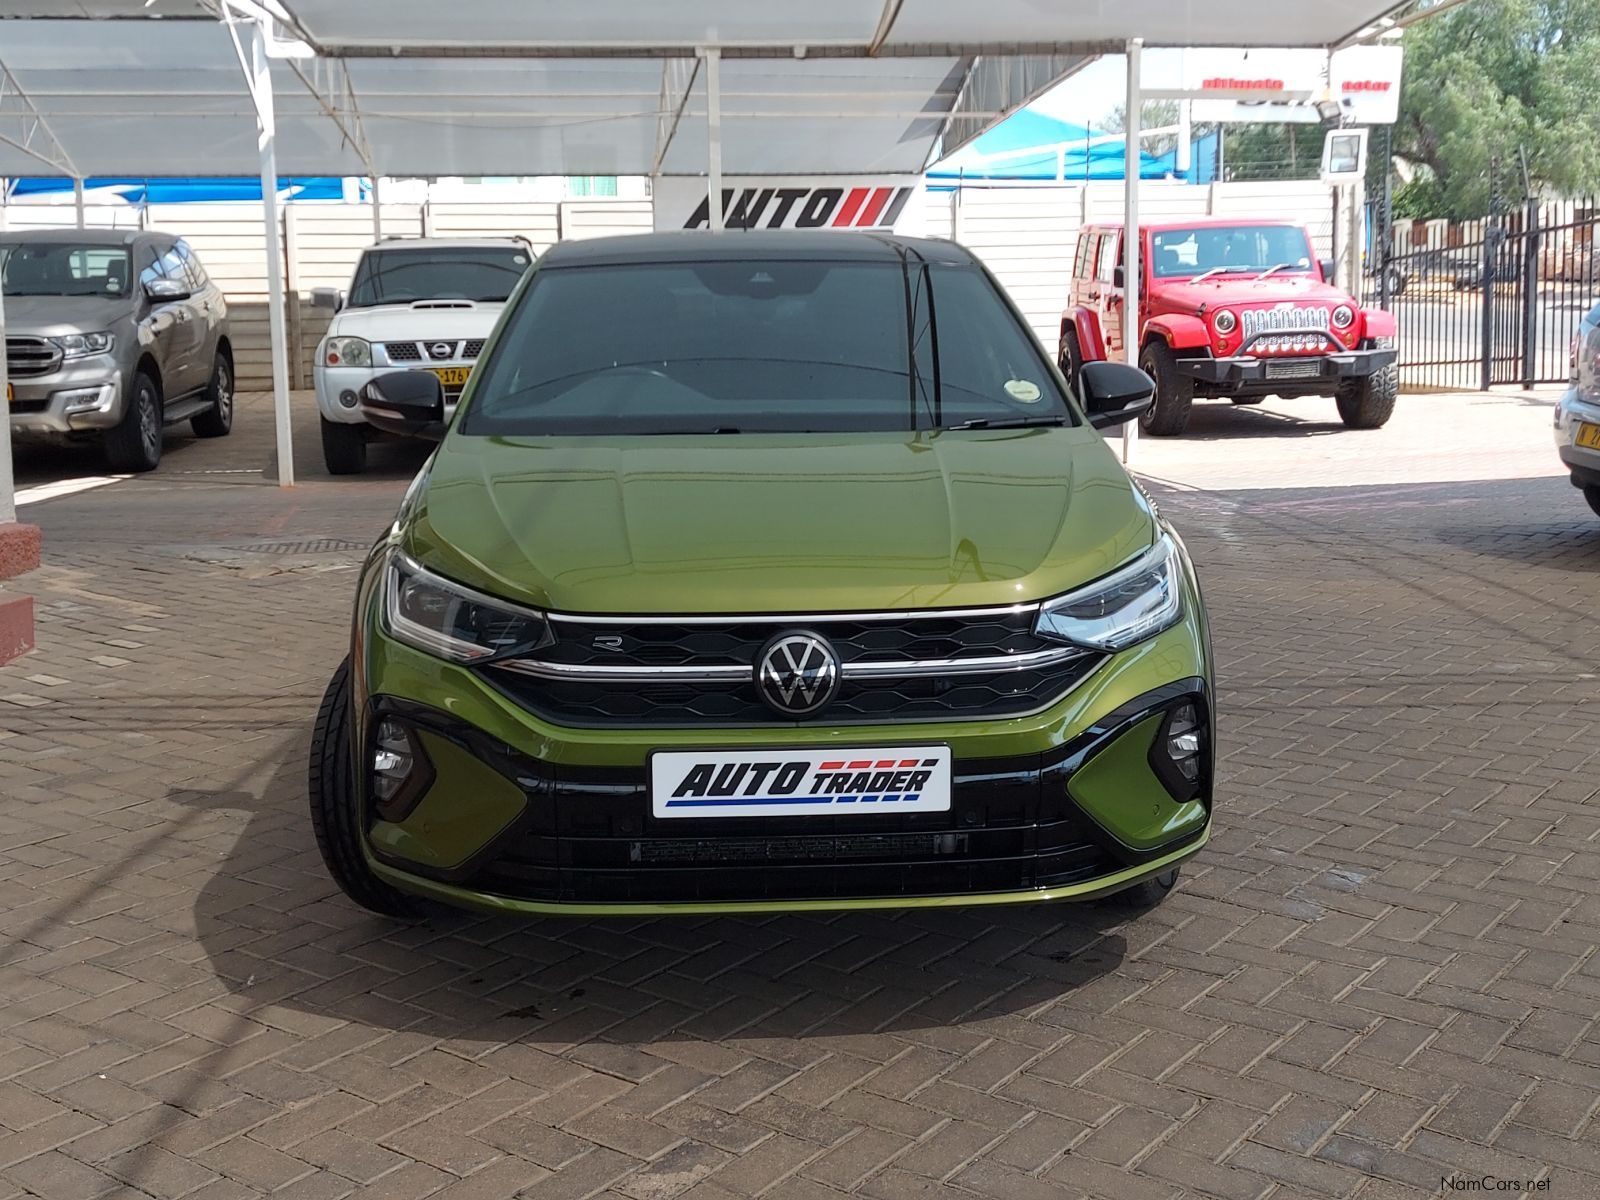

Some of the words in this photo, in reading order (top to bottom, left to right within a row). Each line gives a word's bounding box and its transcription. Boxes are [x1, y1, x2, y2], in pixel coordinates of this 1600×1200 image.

[683, 187, 844, 228] AUTO
[671, 762, 811, 797] AUTO
[809, 770, 933, 795] TRADER
